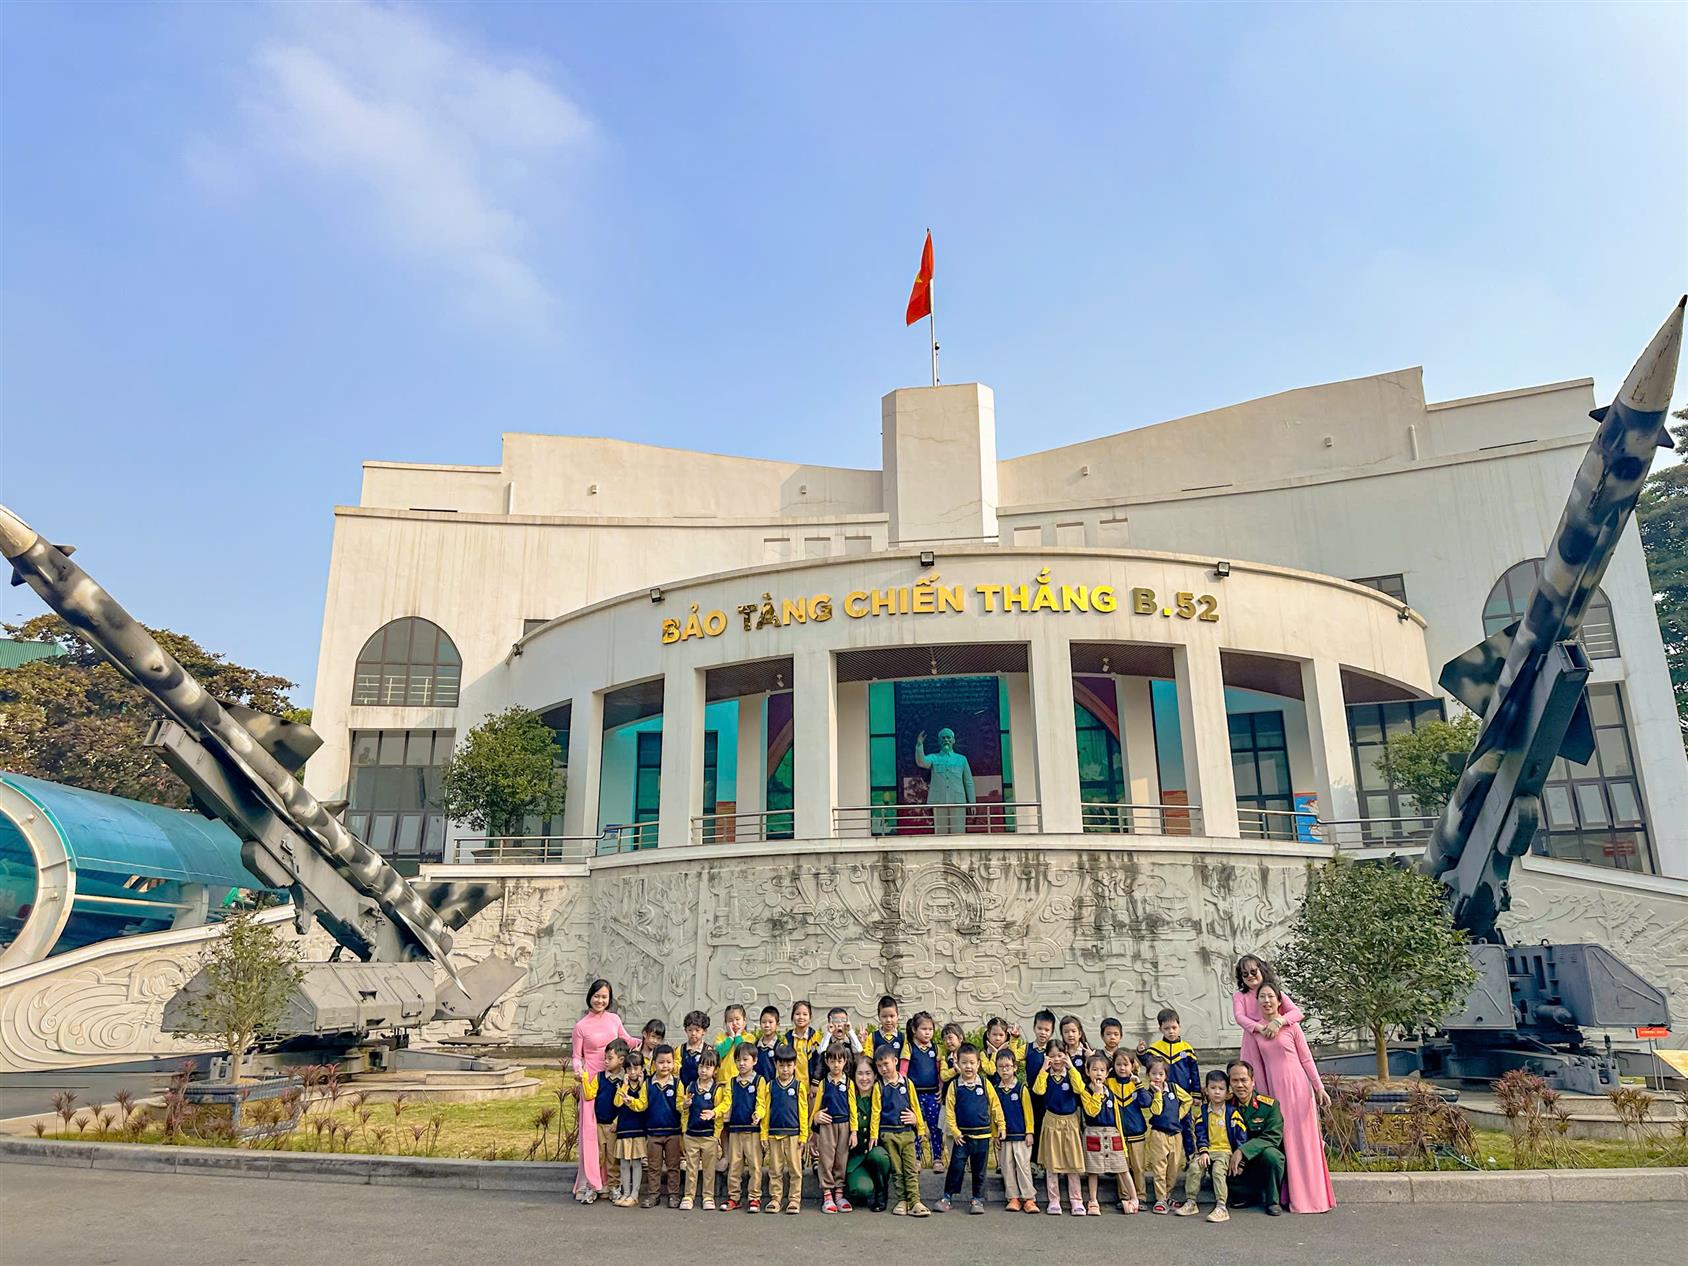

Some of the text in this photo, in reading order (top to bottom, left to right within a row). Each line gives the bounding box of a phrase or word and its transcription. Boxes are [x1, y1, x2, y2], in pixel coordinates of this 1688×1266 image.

[661, 567, 1220, 644] BẢO TÀNG CHIẾN THẮNG B.52
